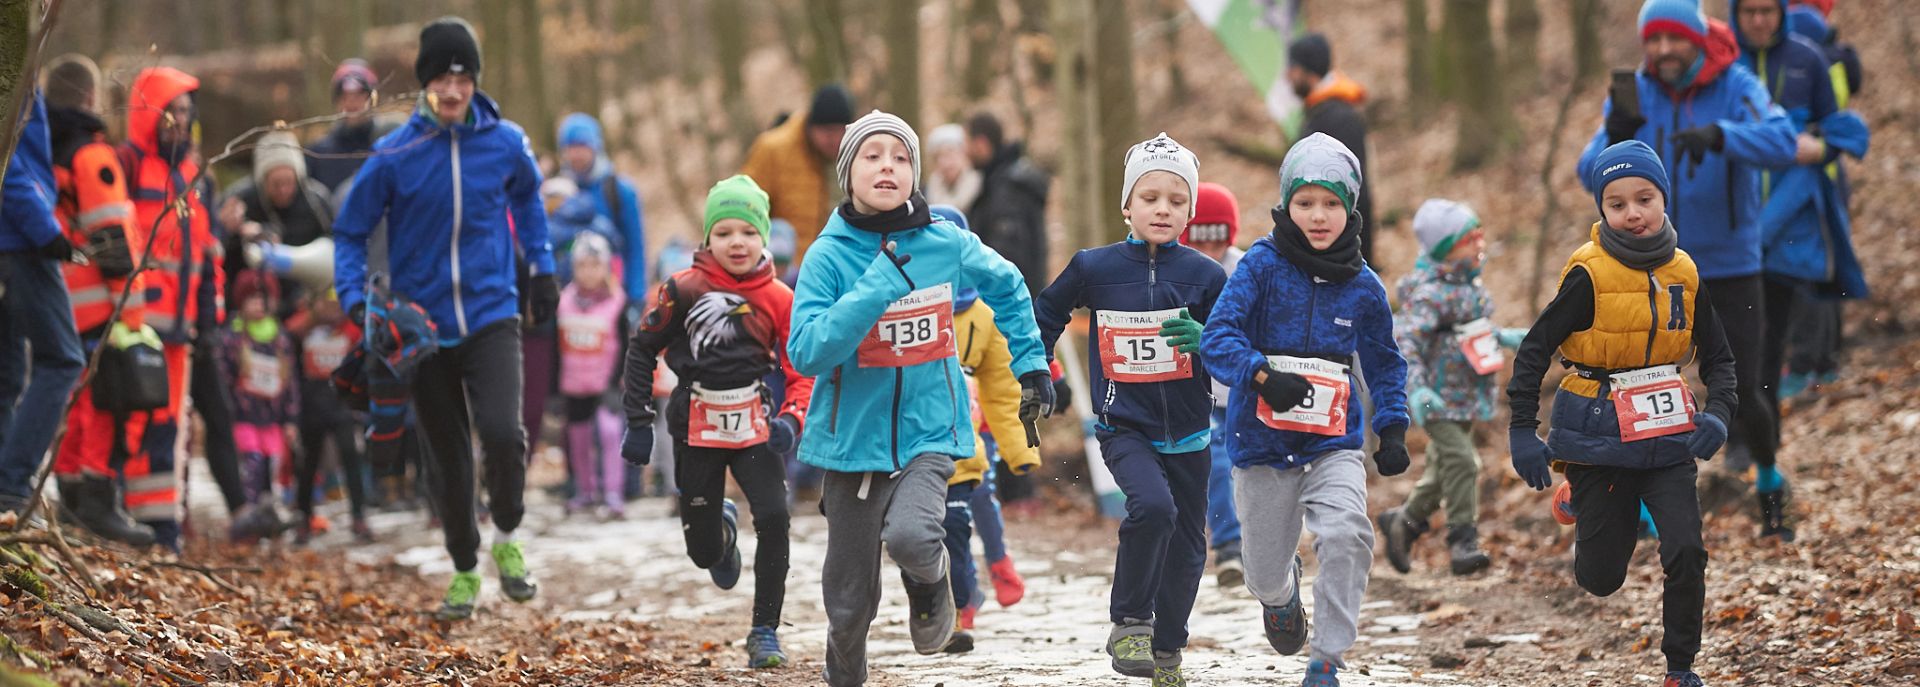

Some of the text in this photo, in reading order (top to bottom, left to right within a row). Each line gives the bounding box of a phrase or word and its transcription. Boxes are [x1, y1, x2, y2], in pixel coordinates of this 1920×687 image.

[1603, 163, 1625, 176] CRAFT
[1667, 284, 1687, 331] A
[885, 318, 932, 346] 138
[1127, 338, 1157, 361] 15
[1129, 365, 1158, 373] MARCEL
[1646, 391, 1675, 416] 13
[719, 413, 742, 431] 17
